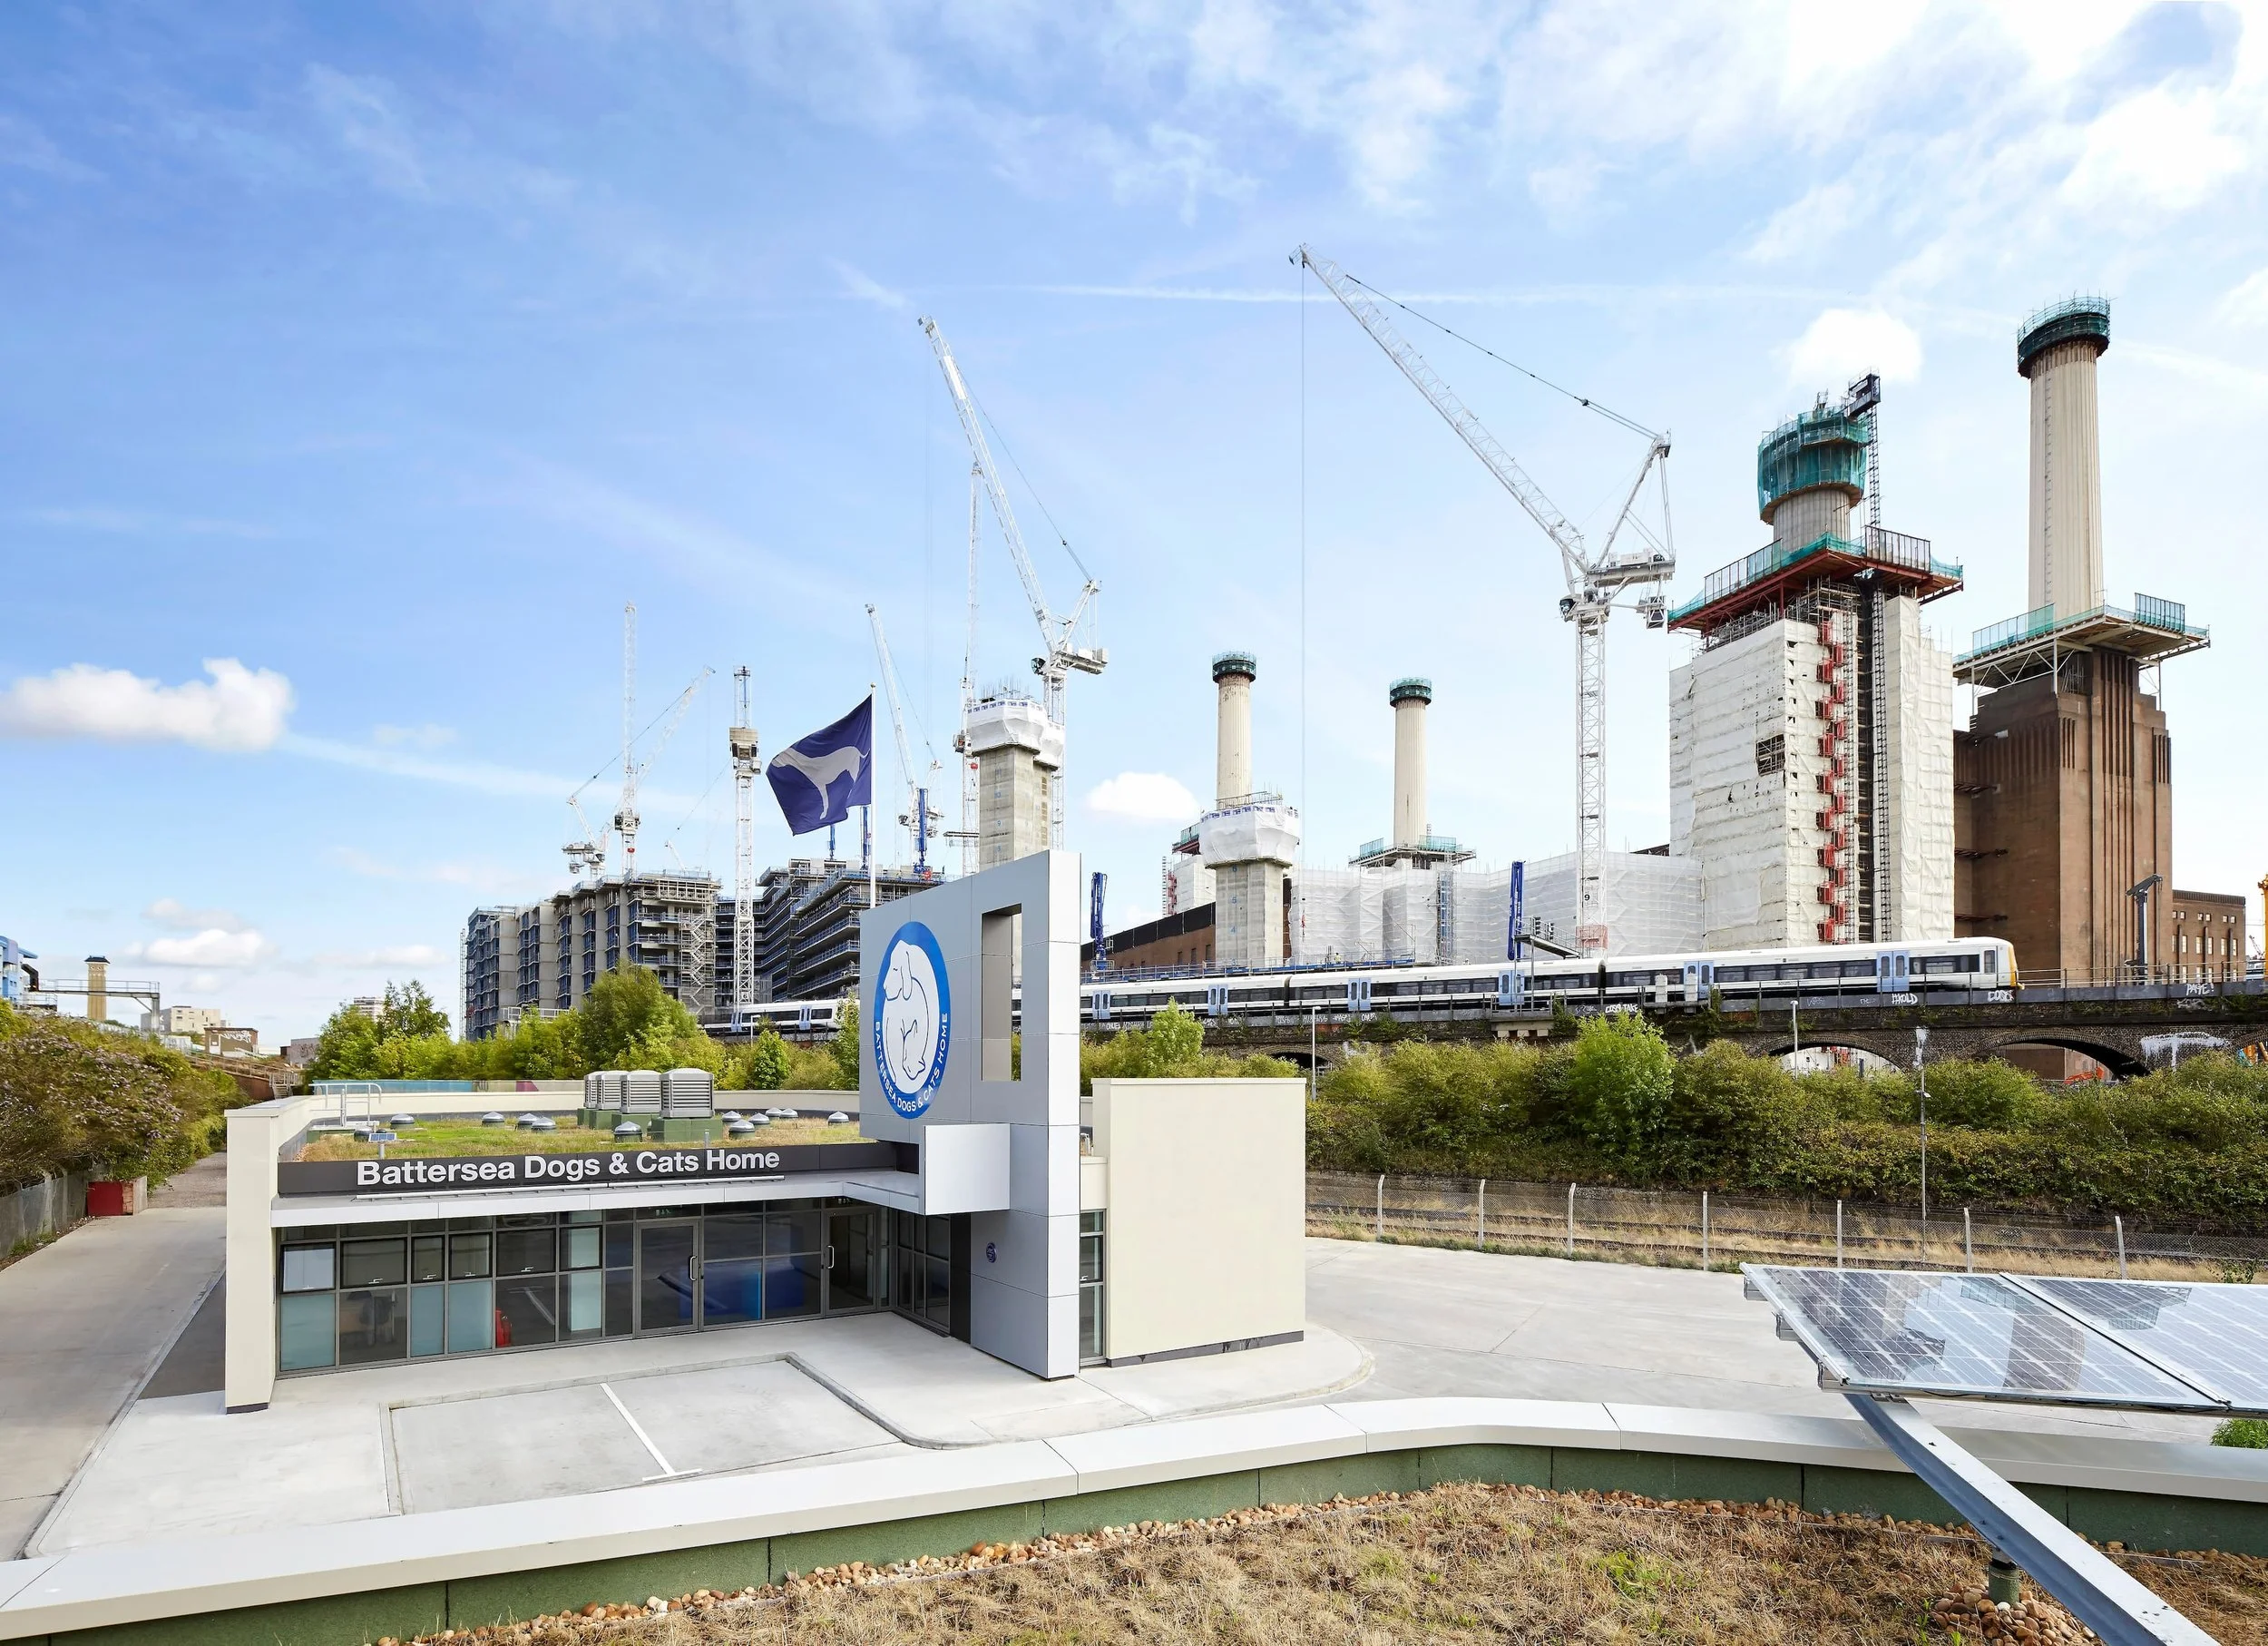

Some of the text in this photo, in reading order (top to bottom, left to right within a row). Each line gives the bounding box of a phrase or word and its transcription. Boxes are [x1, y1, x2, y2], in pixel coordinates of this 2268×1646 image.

[875, 1013, 948, 1112] BATTERSEA DOGS & CATS HOME
[357, 1149, 780, 1186] Battersea Dogs & Cats Home
